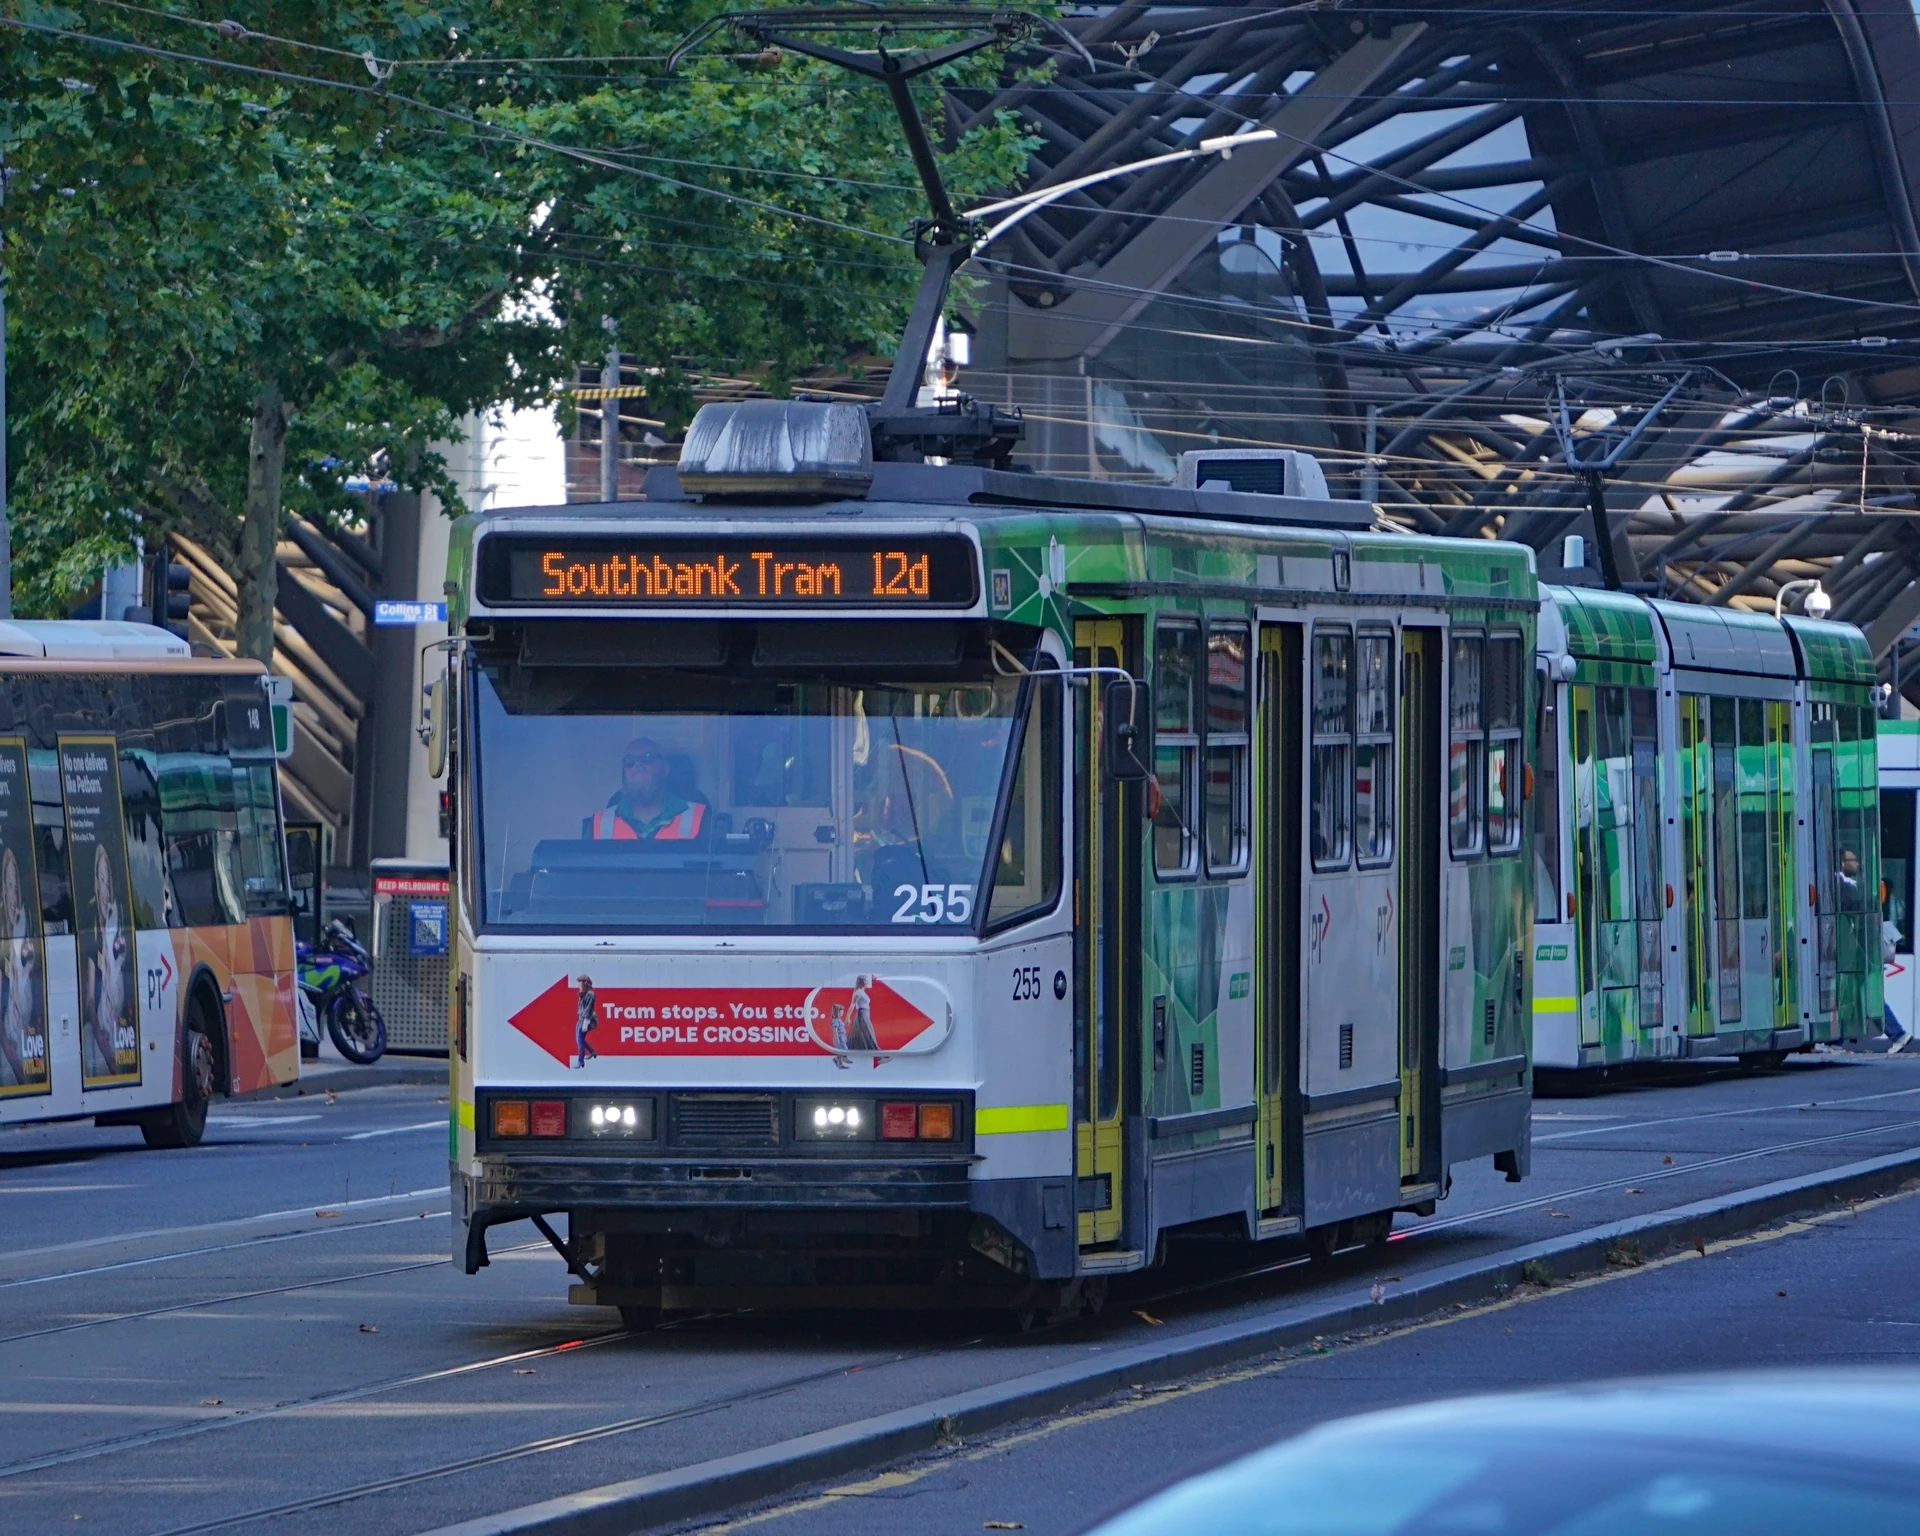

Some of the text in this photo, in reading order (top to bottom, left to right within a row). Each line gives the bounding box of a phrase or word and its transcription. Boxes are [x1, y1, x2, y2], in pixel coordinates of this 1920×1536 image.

[543, 551, 930, 595] Southbank Tram 12d
[379, 603, 438, 615] Collins St
[63, 752, 108, 772] No one delivers
[65, 774, 77, 793] like
[378, 880, 397, 892] KEEP
[398, 881, 441, 893] MELBOURNE
[892, 884, 972, 923] 255
[1012, 966, 1041, 1001] 255
[602, 1003, 655, 1019] Tram
[661, 1004, 725, 1022] stops.
[729, 1003, 768, 1019] You
[21, 1029, 44, 1058] Love
[113, 1020, 135, 1048] Love
[620, 1026, 811, 1043] PEOPLE CROSSING
